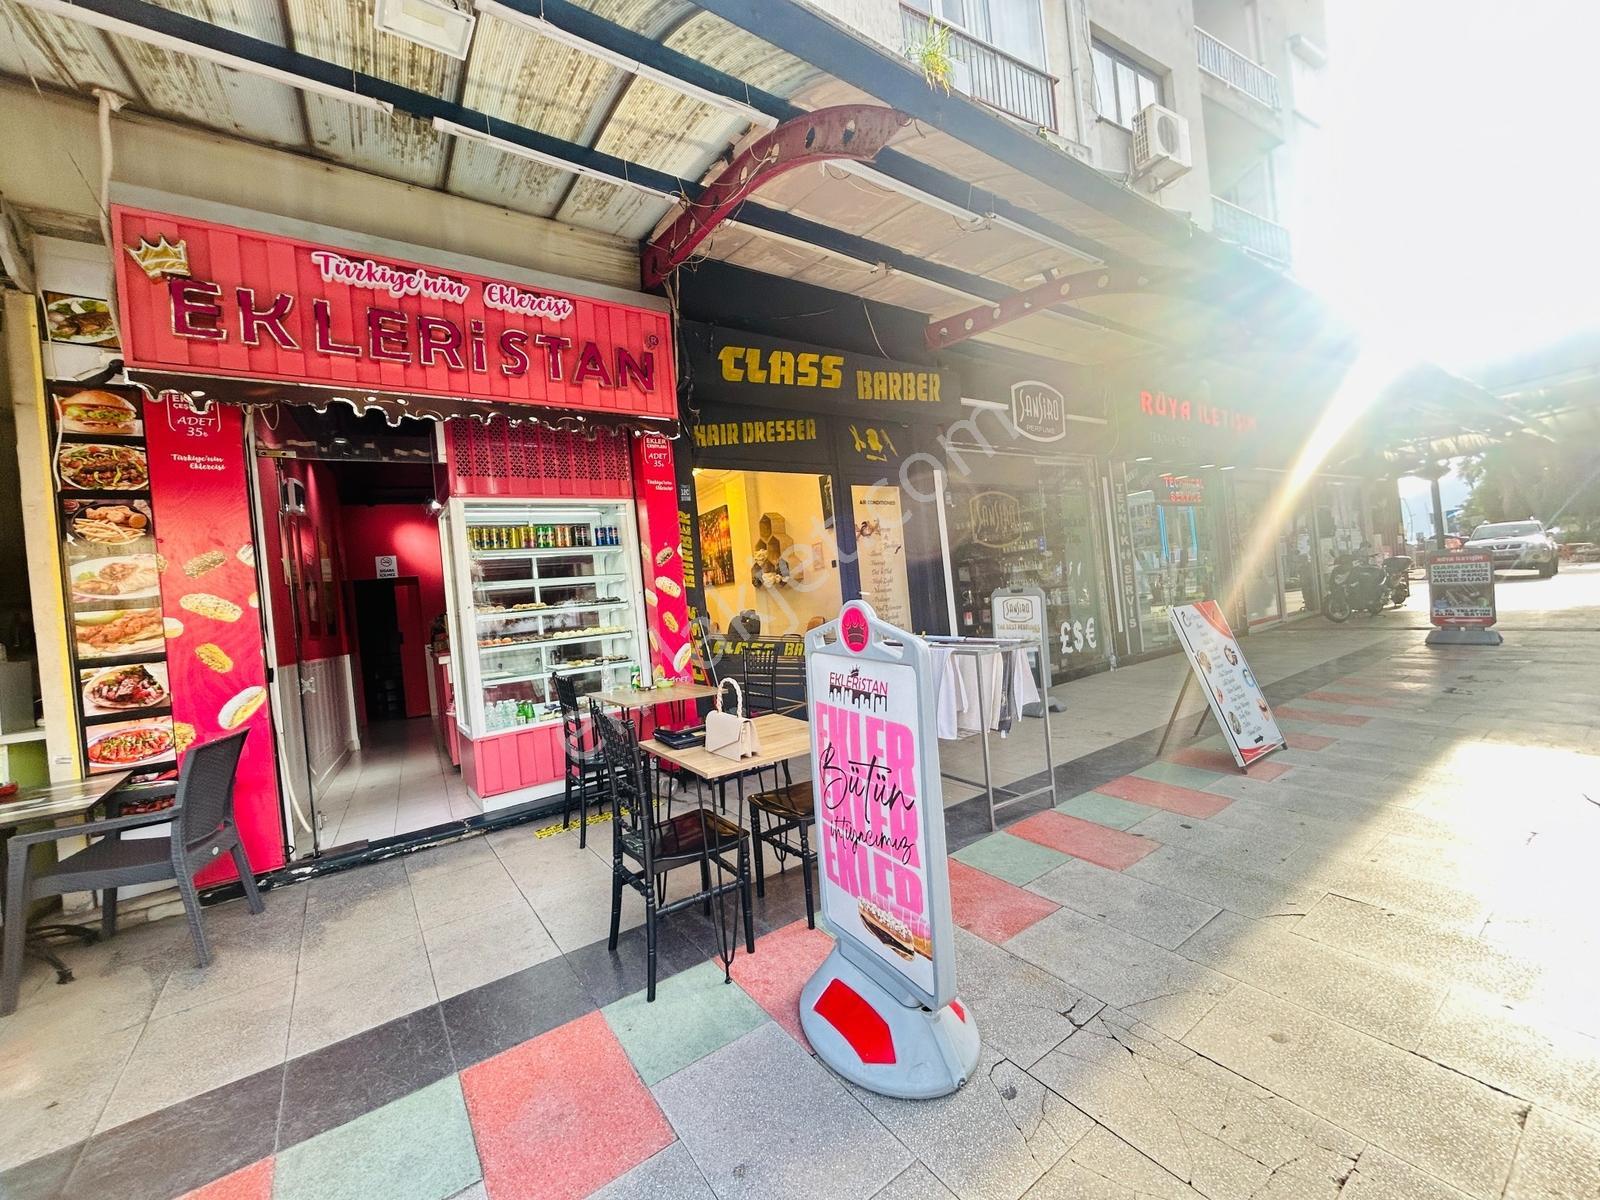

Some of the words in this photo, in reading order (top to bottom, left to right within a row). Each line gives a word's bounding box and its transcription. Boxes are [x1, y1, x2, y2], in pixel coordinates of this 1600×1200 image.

[311, 251, 469, 305] Türkiye'nin
[483, 281, 574, 322] Eklercisi
[718, 345, 845, 389] CLASS
[856, 370, 941, 402] BARBER
[177, 416, 216, 427] ADET
[693, 423, 740, 448] HAIR
[742, 418, 817, 444] DRESSER
[819, 742, 915, 824] Bütün
